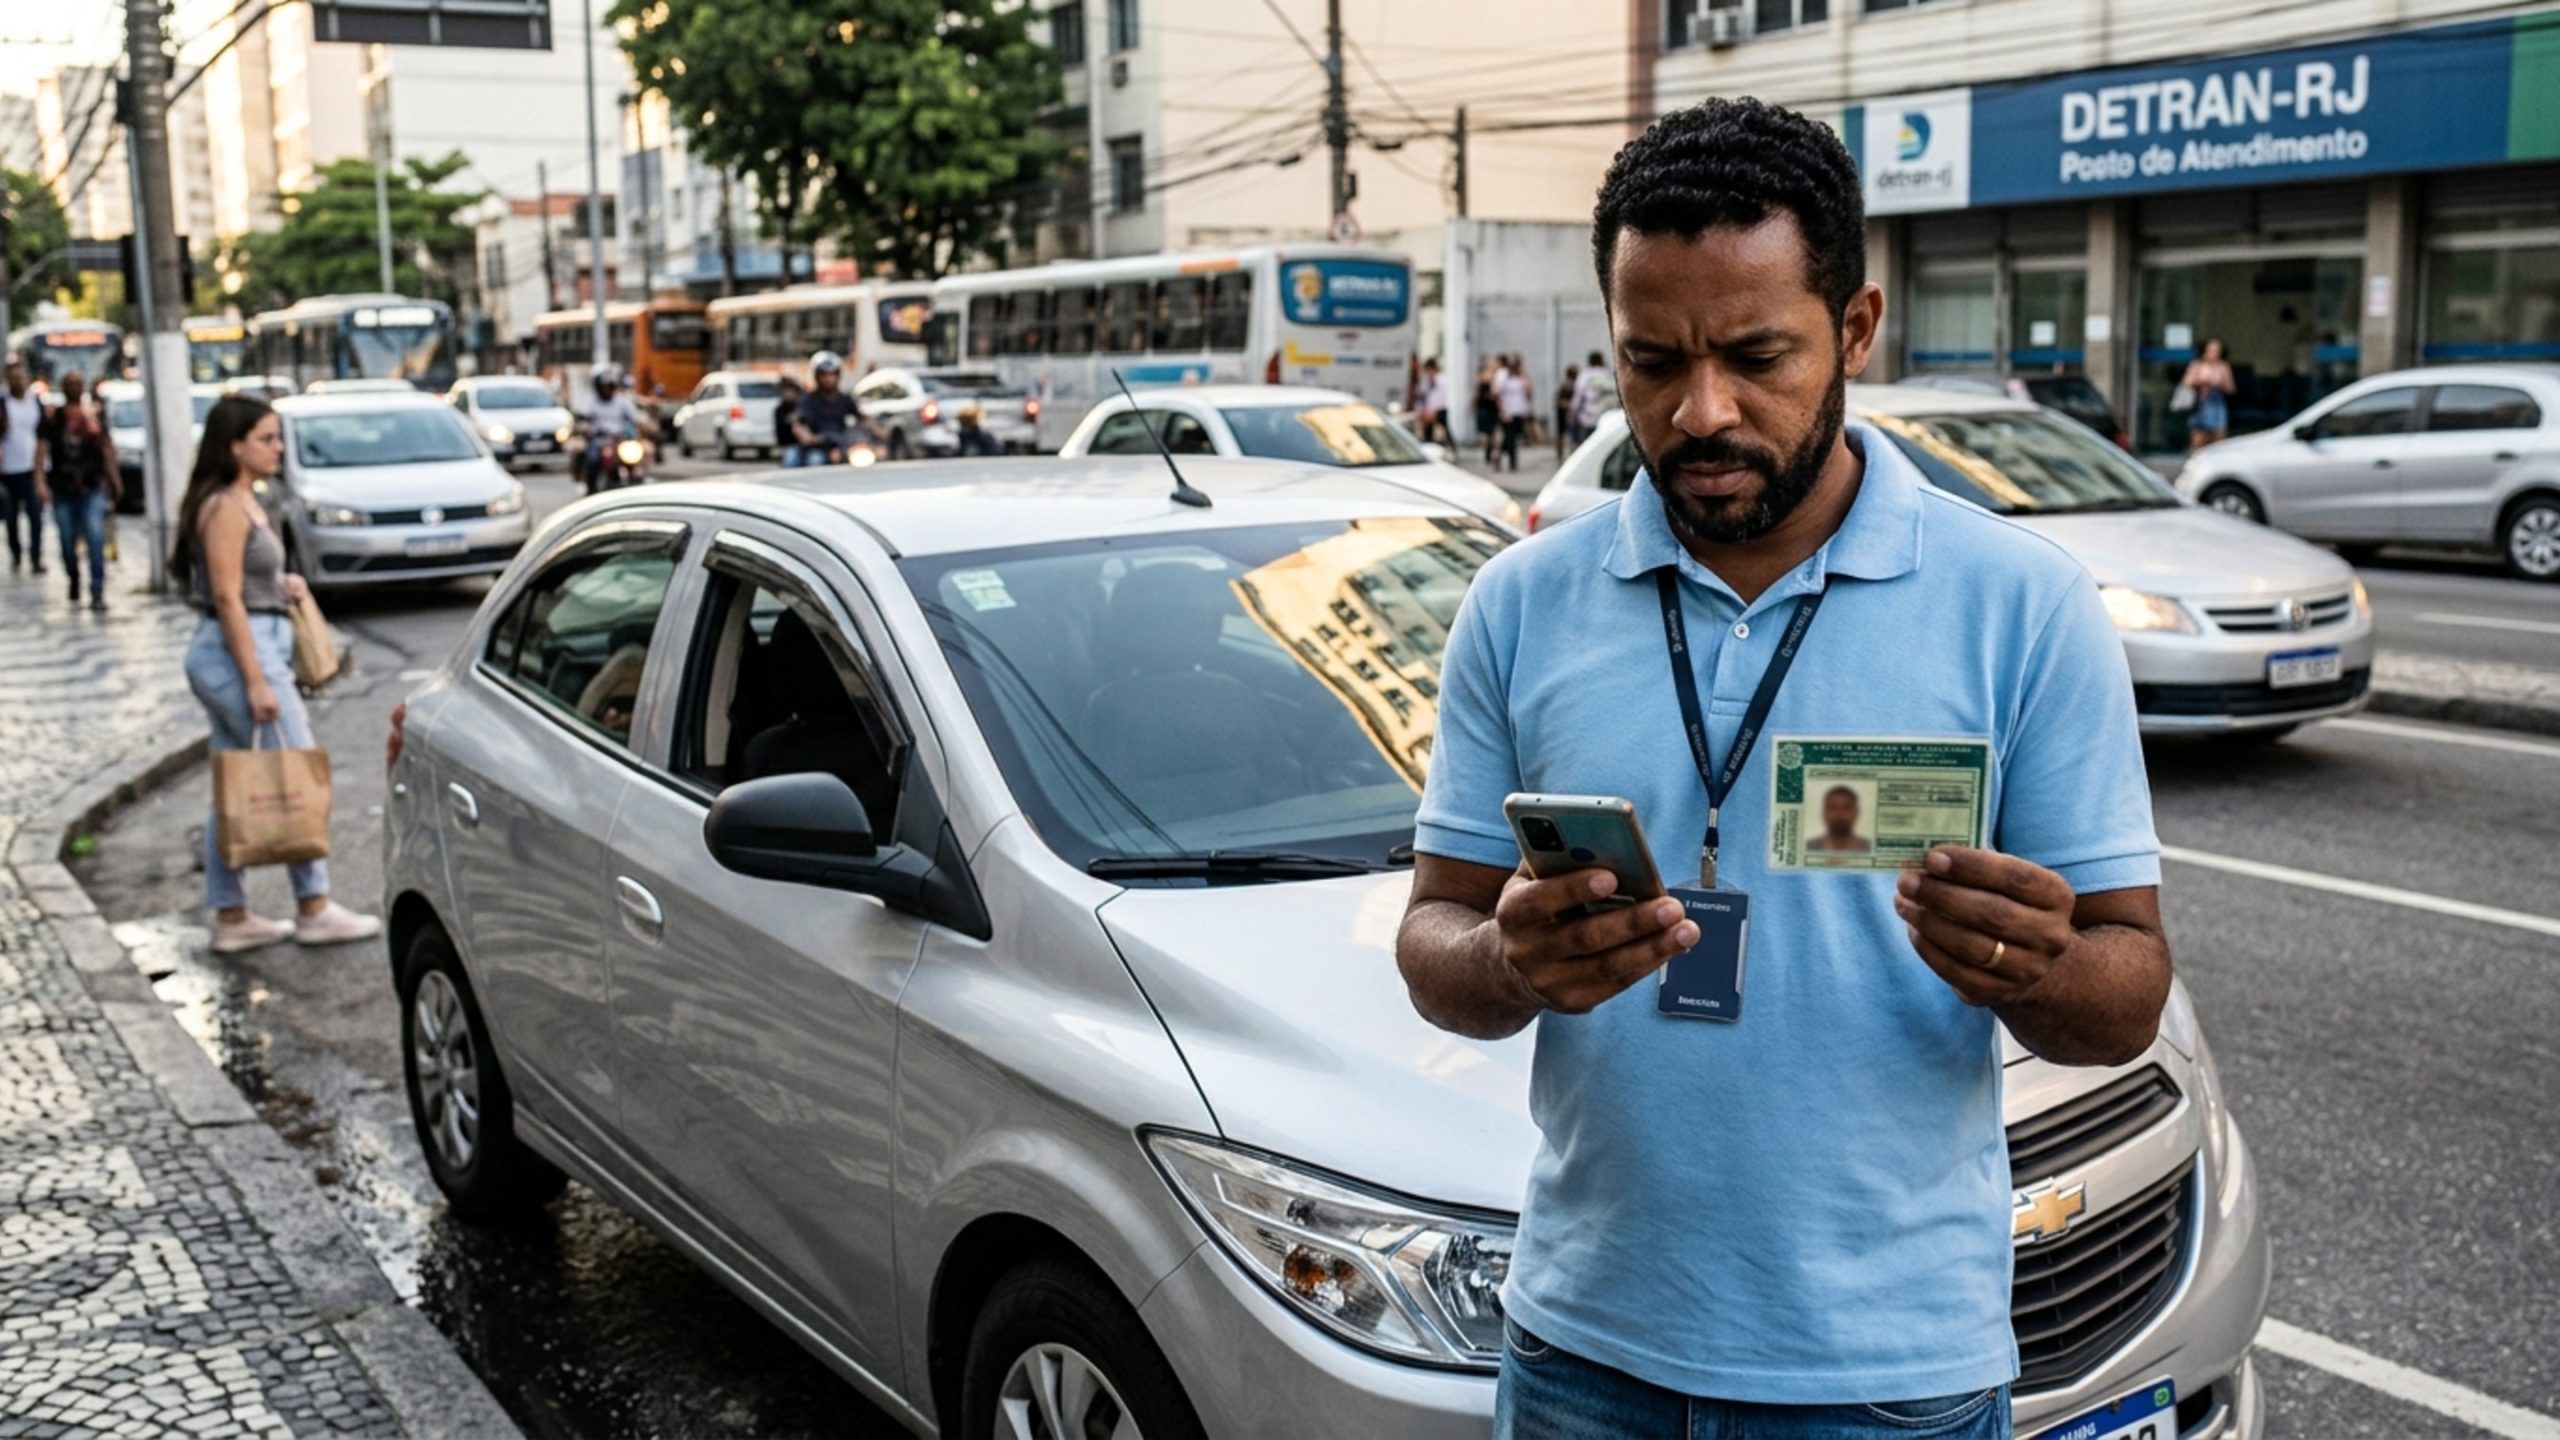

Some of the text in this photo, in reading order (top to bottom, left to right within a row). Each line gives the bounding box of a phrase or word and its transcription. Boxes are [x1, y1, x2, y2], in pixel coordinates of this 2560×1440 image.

[2061, 55, 2370, 143] DETRAN-RJ
[2060, 128, 2368, 182] Posto de Atendimento
